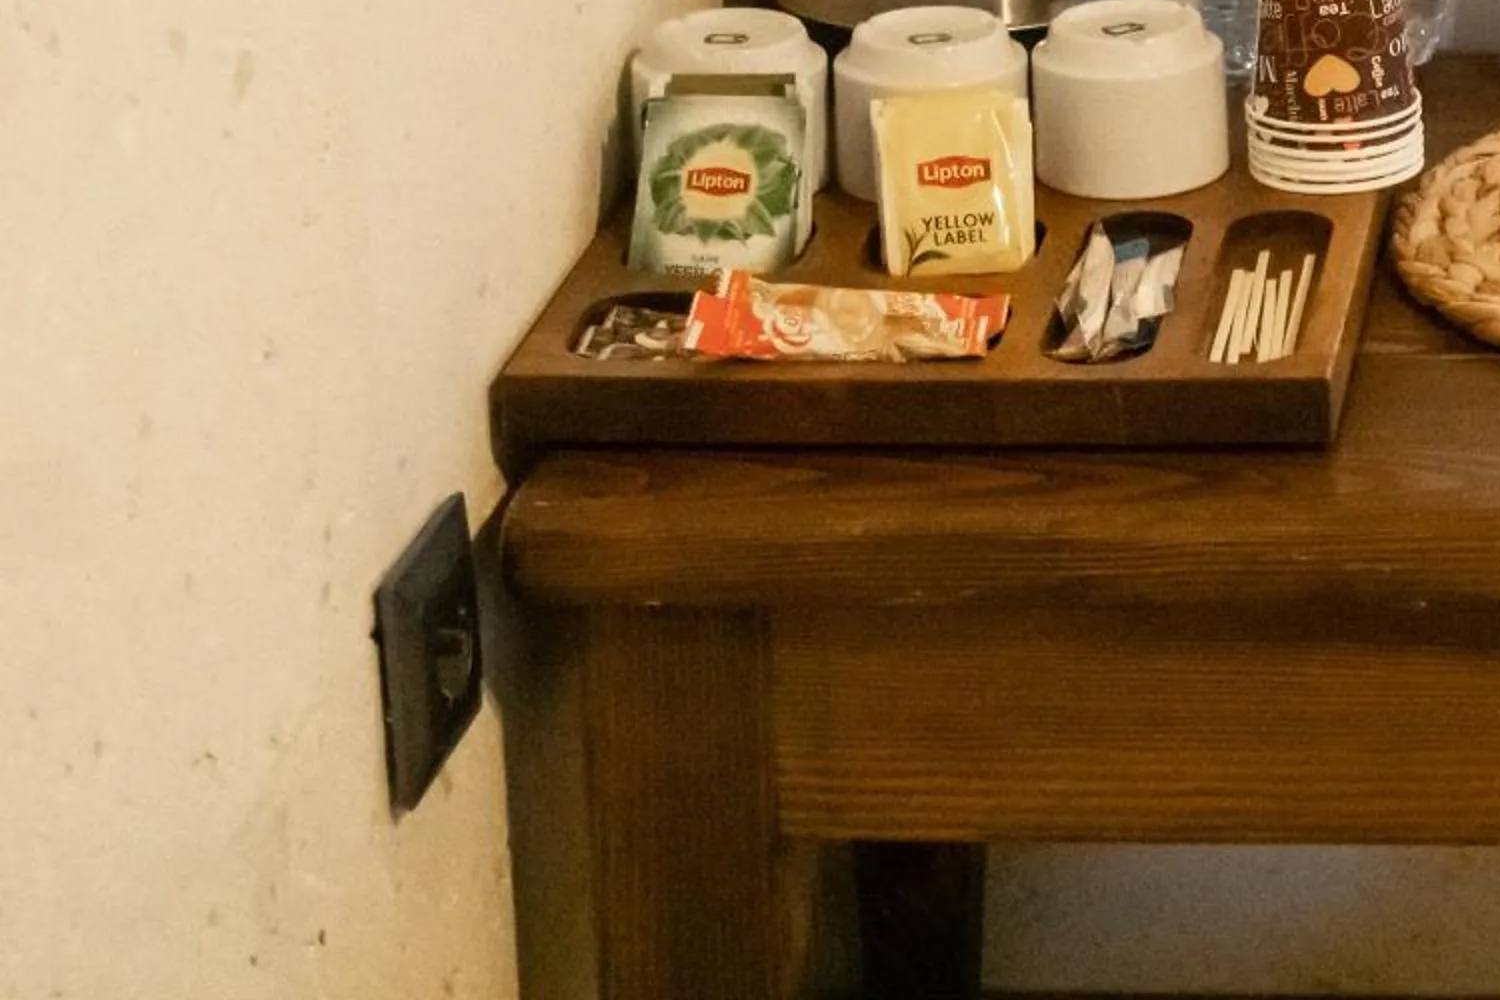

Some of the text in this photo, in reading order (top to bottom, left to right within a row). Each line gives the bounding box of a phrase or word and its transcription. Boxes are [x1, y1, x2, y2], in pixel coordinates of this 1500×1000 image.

[1318, 1, 1350, 16] Tea
[691, 168, 747, 193] Lipton
[923, 163, 986, 184] Lipton
[921, 212, 995, 232] YELLOW
[933, 230, 987, 246] LABEL
